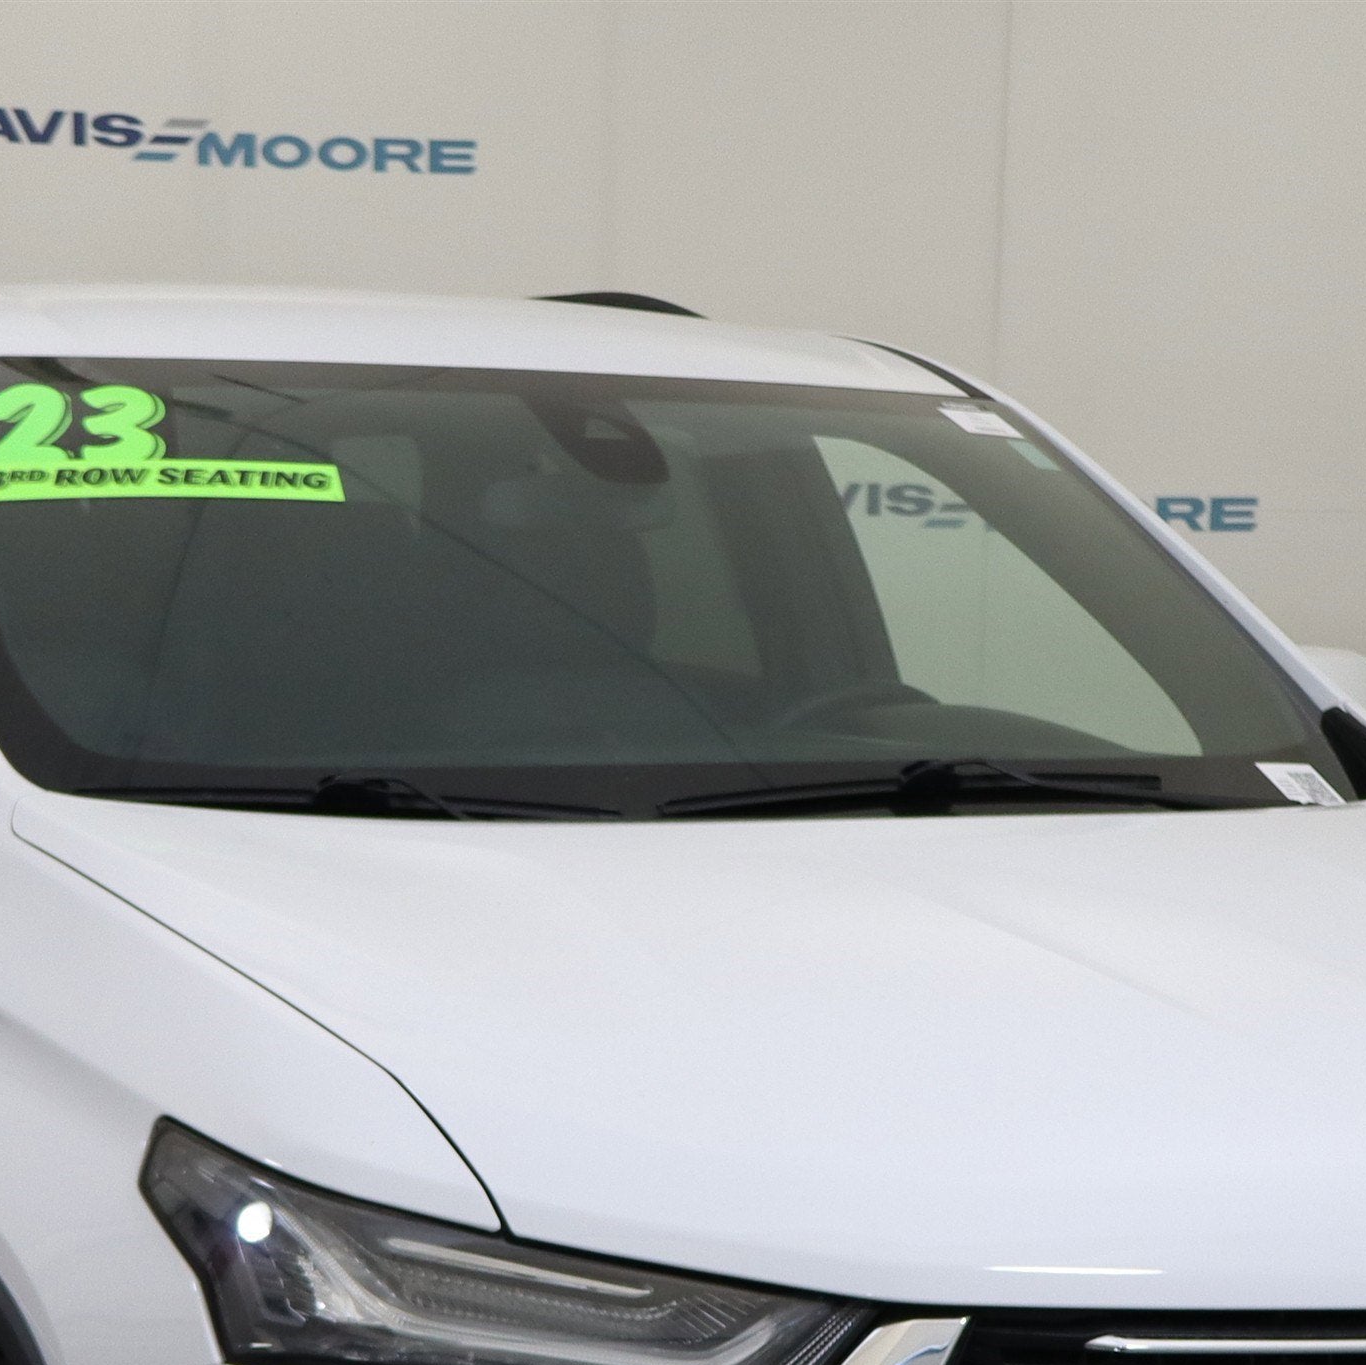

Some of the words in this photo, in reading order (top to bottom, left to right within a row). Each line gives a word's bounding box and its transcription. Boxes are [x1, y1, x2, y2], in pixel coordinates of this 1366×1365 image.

[197, 132, 477, 174] MOORE
[53, 467, 146, 487] ROW
[158, 467, 328, 490] SEATING
